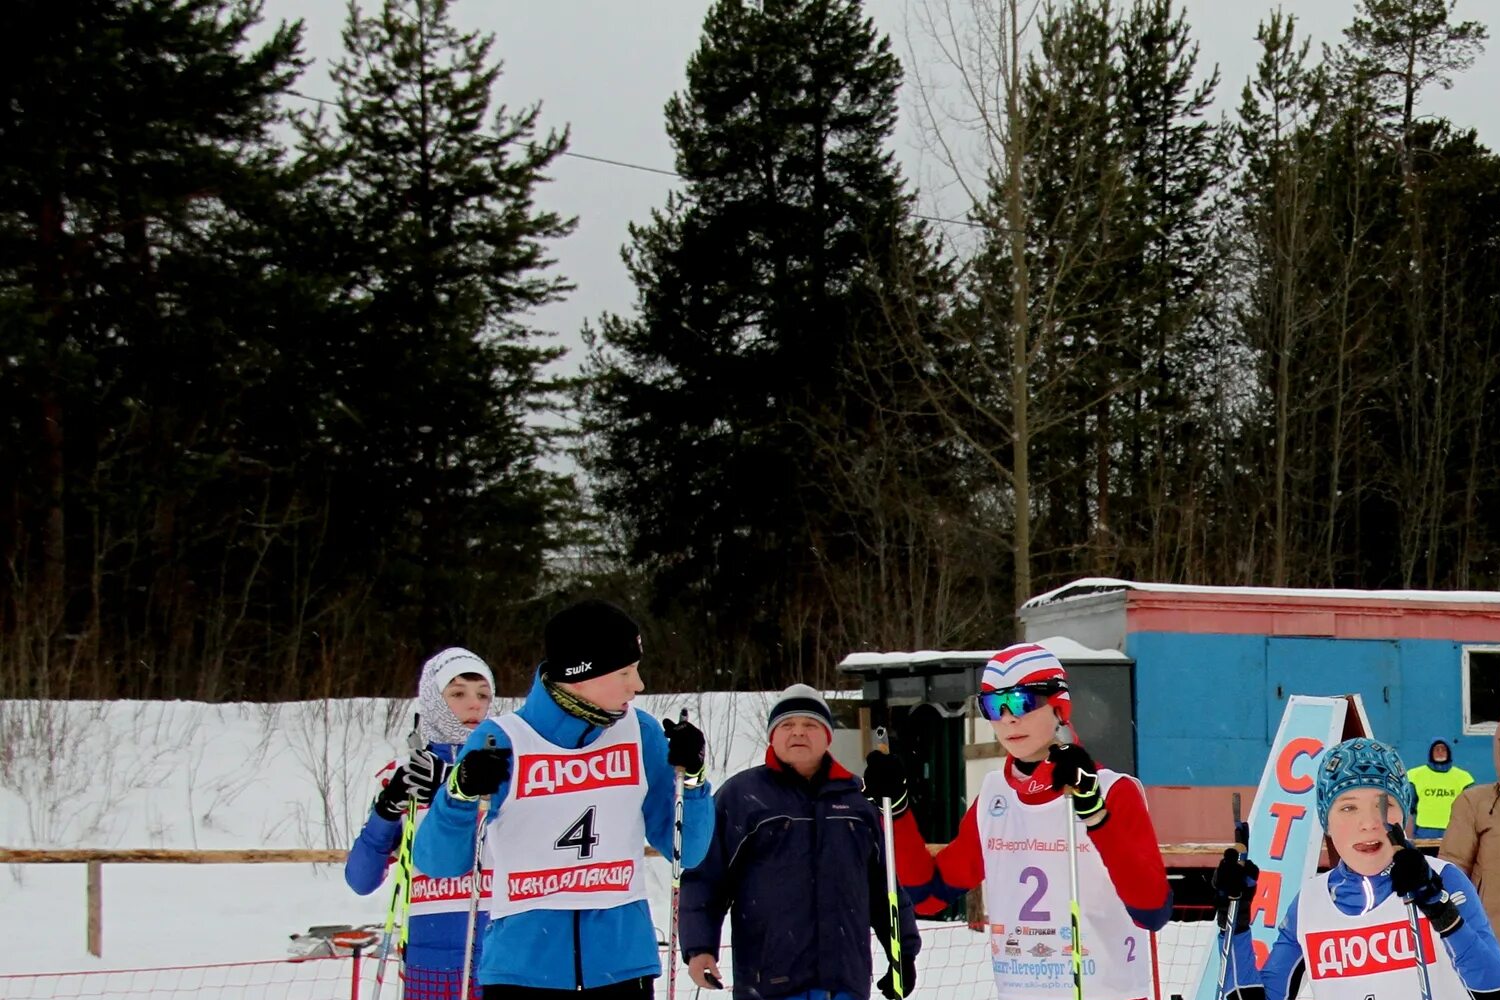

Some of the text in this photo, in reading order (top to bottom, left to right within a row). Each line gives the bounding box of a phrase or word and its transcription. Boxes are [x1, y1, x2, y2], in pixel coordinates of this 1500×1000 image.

[525, 750, 632, 796] ДЮСШ
[1424, 788, 1455, 798] СУДЬЯ
[554, 805, 600, 860] 4
[509, 865, 633, 897] КАНДАЛАКША
[1018, 866, 1051, 922] 2
[1068, 959, 1096, 976] 210
[1124, 936, 1137, 962] 2
[1318, 928, 1418, 977] ДЮСШ
